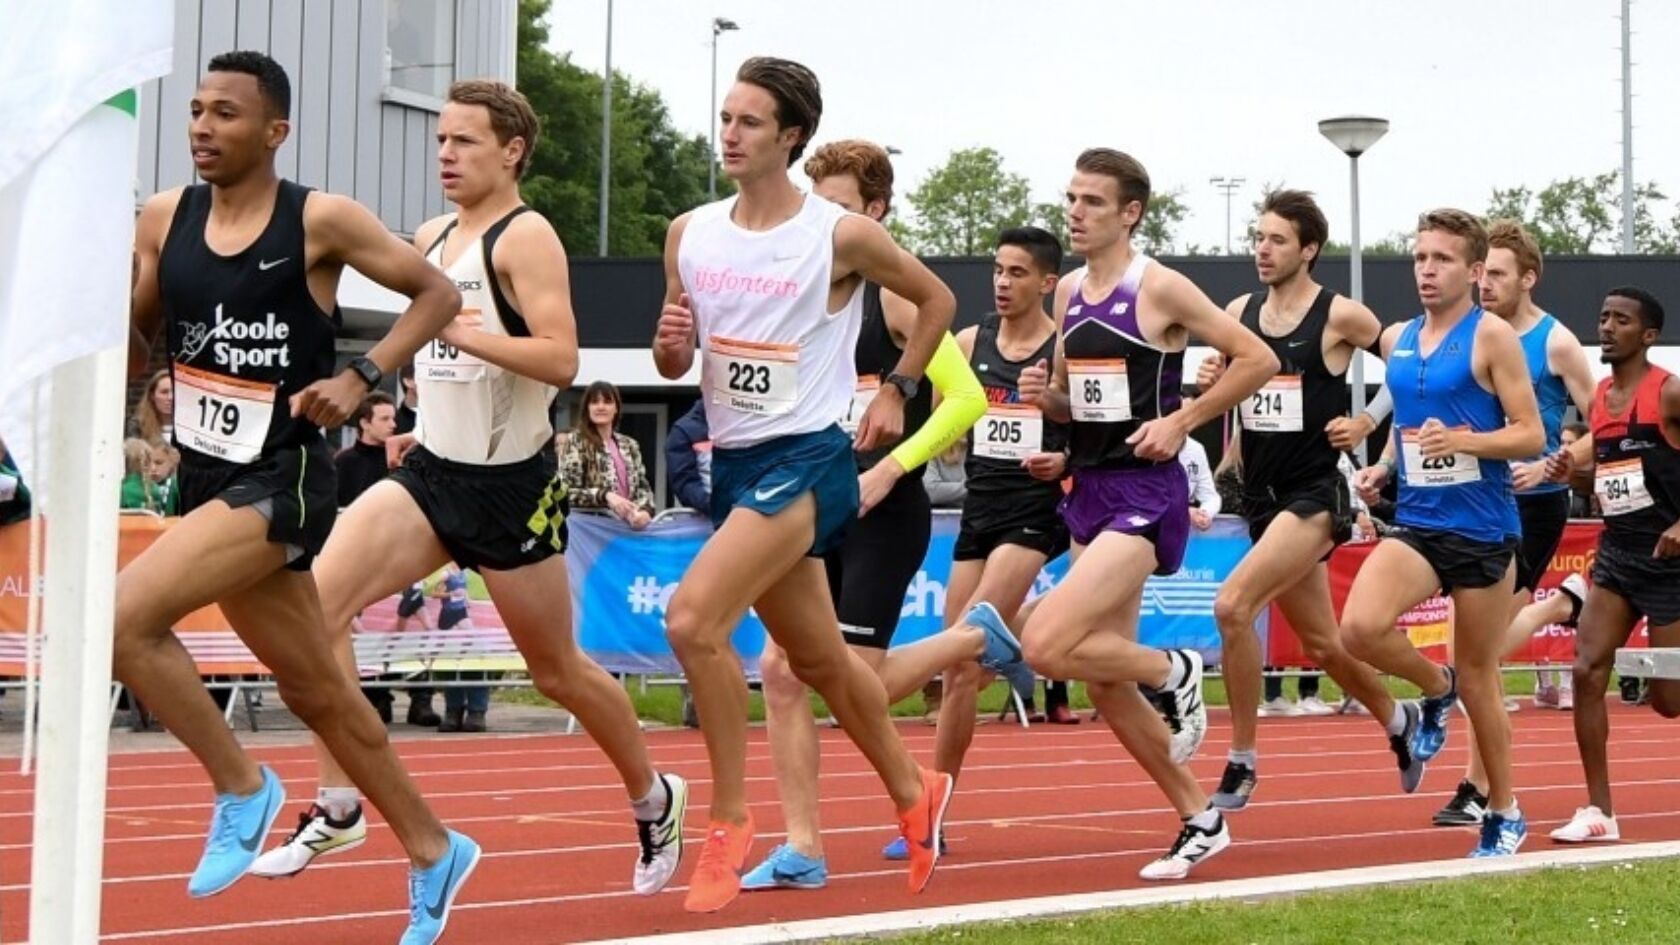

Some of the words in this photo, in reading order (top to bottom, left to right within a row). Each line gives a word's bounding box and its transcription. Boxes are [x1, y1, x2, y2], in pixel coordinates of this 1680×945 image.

[696, 266, 799, 298] ijsfontein
[213, 342, 290, 374] Sport
[728, 362, 770, 394] 223
[1083, 379, 1102, 403] 86
[198, 395, 240, 436] 179
[1252, 393, 1282, 415] 214
[987, 419, 1021, 443] 205
[194, 436, 228, 455] Deloitte
